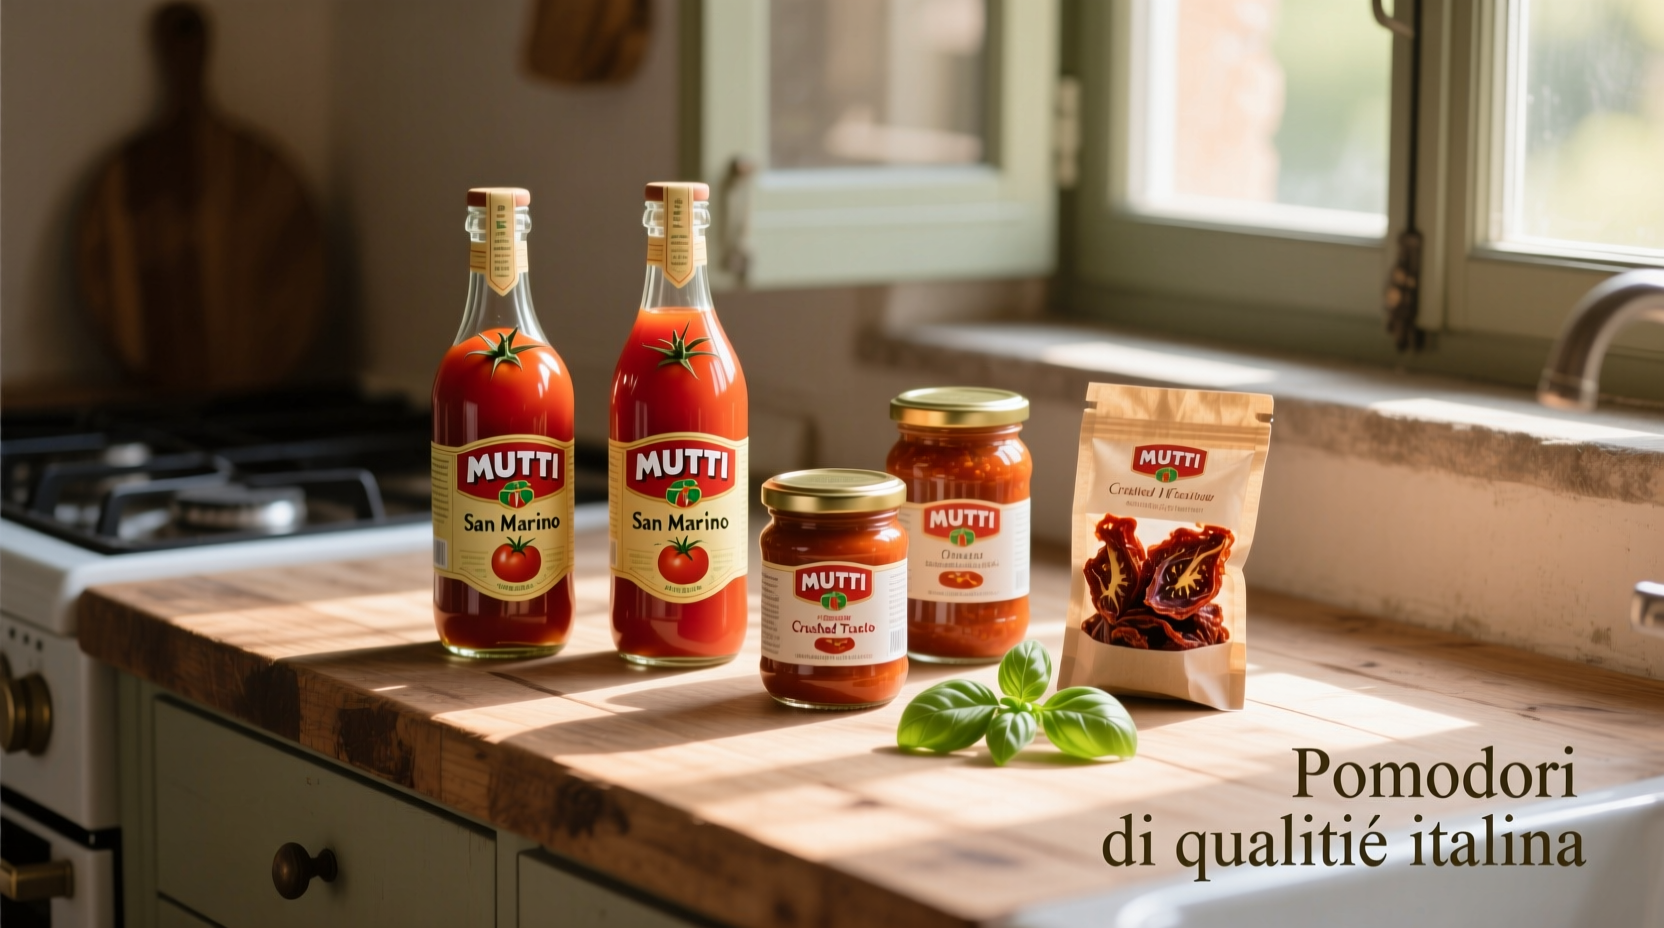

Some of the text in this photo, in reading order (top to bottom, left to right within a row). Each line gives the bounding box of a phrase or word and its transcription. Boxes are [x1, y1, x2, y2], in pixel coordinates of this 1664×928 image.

[467, 451, 559, 484] MUTTI
[635, 448, 728, 481] MUTTI
[1139, 449, 1201, 469] MUTTI
[464, 512, 561, 532] San Marino
[632, 511, 729, 531] San Marino
[929, 508, 995, 529] MUTTI
[801, 571, 866, 592] MUTTI
